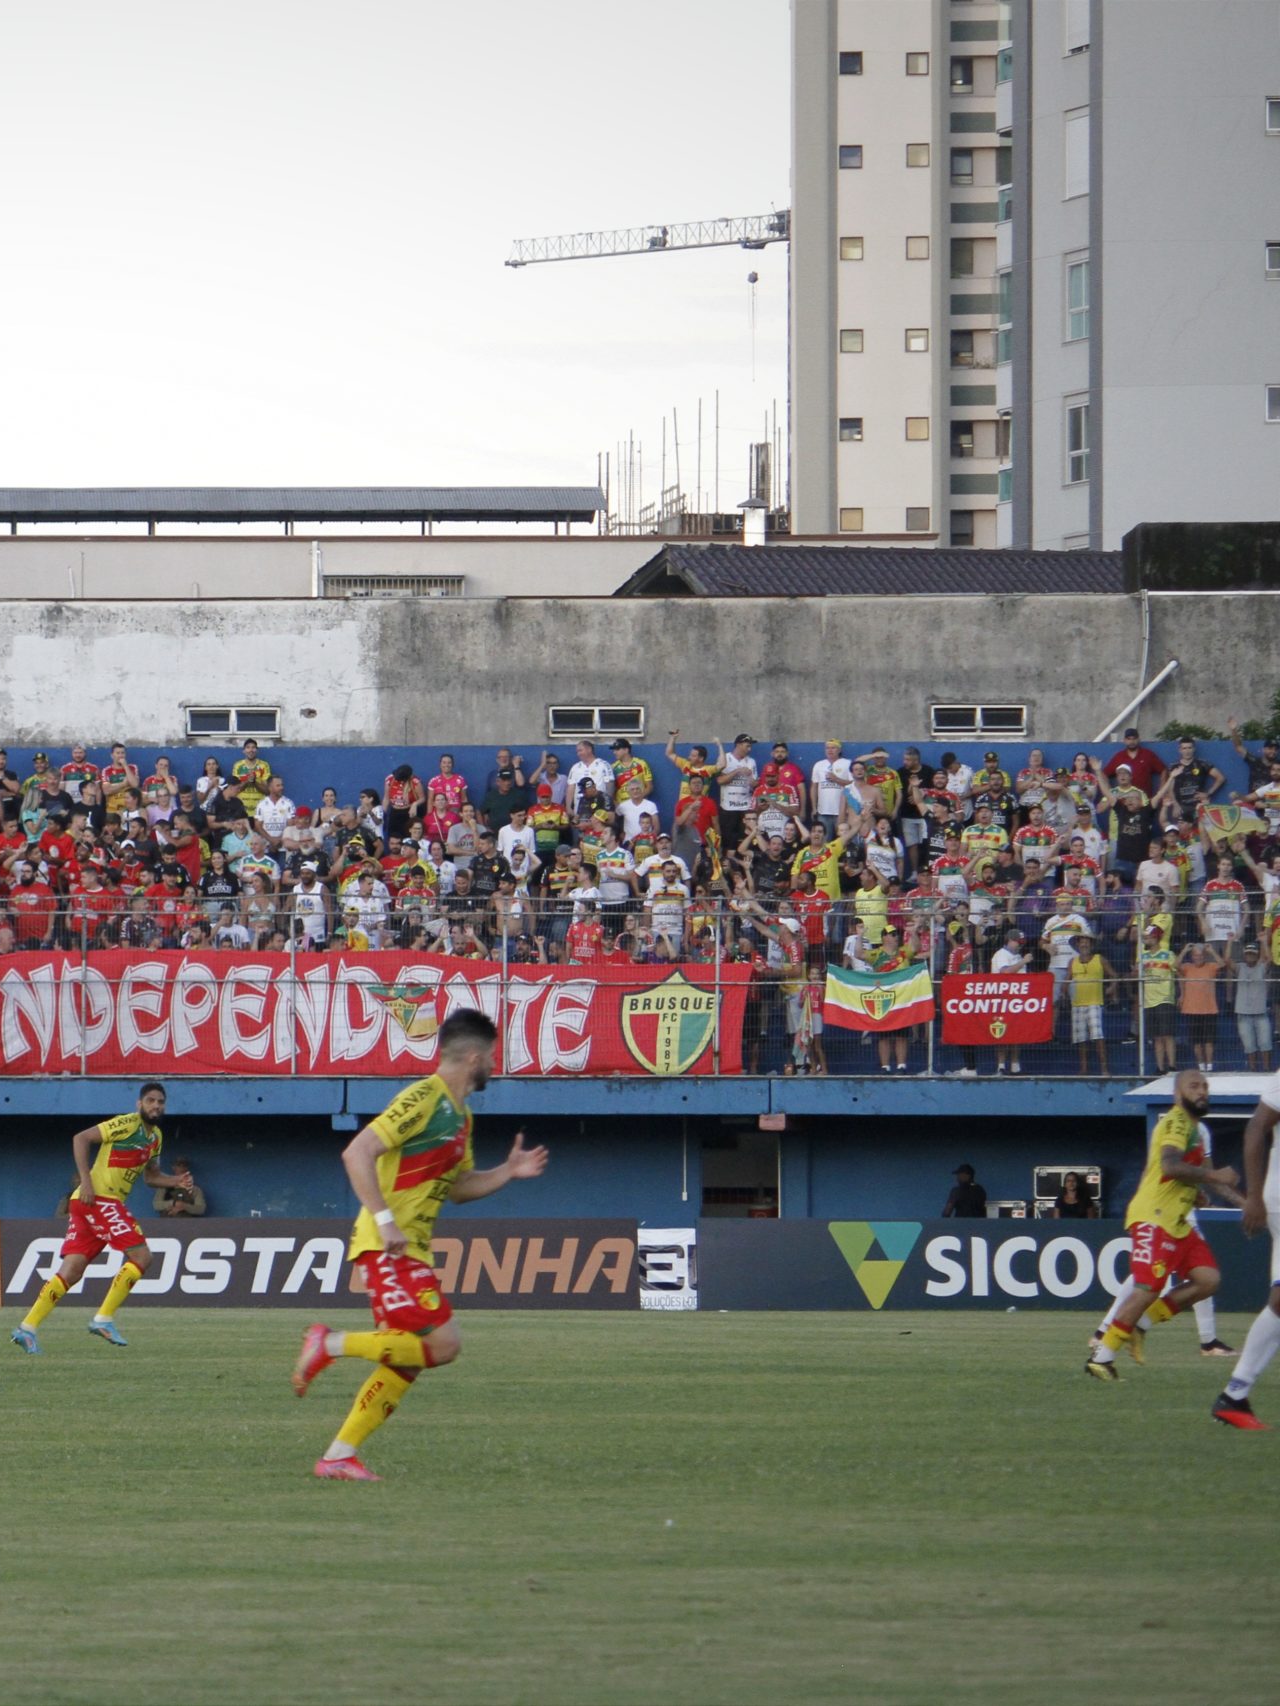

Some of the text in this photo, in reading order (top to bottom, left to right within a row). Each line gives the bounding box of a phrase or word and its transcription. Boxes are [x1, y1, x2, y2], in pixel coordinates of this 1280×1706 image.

[964, 981, 1030, 996] SEMPRE
[629, 996, 715, 1011] BRUSQUE
[663, 1012, 677, 1022] FC
[946, 997, 1047, 1015] CONTIGO!
[386, 1083, 435, 1123] HAVAN
[96, 1200, 132, 1237] BALY
[5, 1237, 635, 1294] APOSTA ANHA
[925, 1235, 1190, 1298] SICOO
